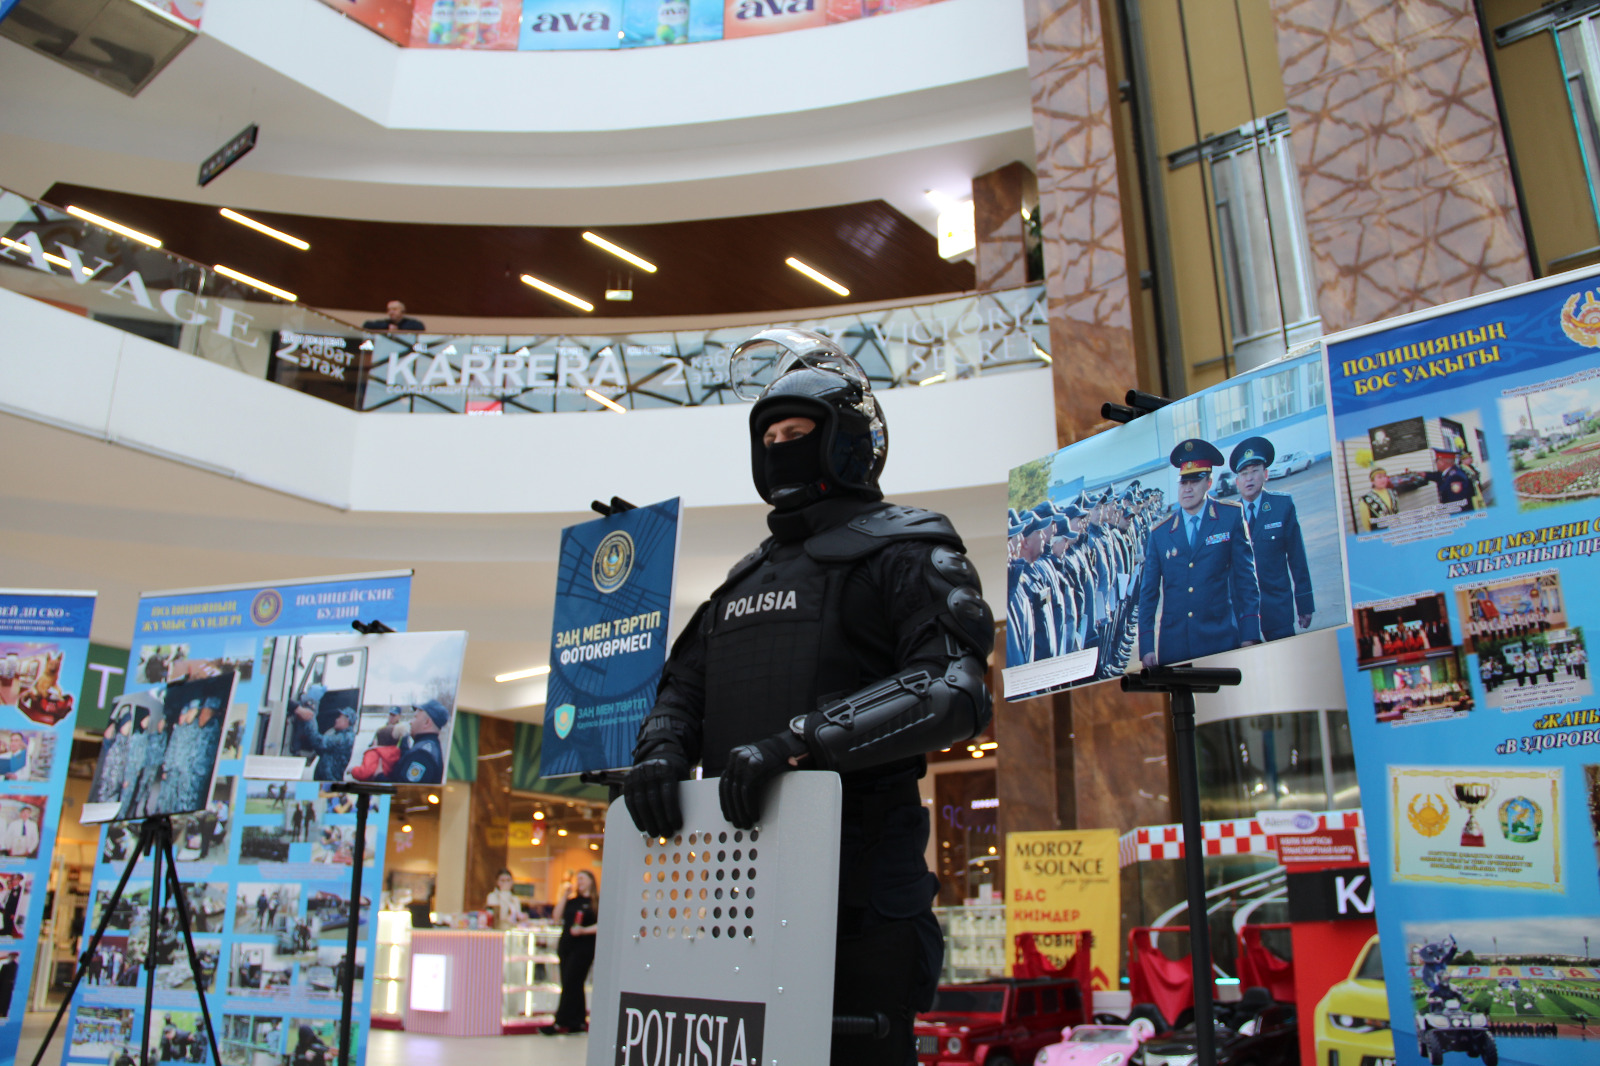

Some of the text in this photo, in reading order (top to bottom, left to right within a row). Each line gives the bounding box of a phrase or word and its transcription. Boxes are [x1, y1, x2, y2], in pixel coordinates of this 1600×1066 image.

[532, 12, 611, 33] ava
[735, 0, 815, 20] ava
[872, 300, 1048, 348] VICTORIA
[275, 331, 300, 364] 2
[1342, 322, 1507, 377] ПОЛИЦИЯНЫҢ
[300, 353, 345, 380] этаж
[385, 351, 627, 387] KARRERA
[662, 357, 686, 385] 2
[1354, 371, 1398, 396] БОС
[1402, 345, 1501, 384] УАҚЫТЫ
[1506, 520, 1590, 549] МӘДЕНИ
[1447, 540, 1574, 579] КУЛЬТУРНЫЙ
[296, 588, 395, 606] ПОЛИЦЕЙСКИЕ
[317, 605, 359, 619] БУДНИ
[724, 590, 797, 621] POLISIA
[555, 611, 661, 649] ЗАҢ МЕН ТӘРТІП
[560, 632, 651, 665] ФОТОКӨРМЕСІ
[1014, 840, 1083, 857] MOROZ
[1035, 858, 1104, 875] SOLNCE
[1014, 889, 1046, 901] БАС
[621, 1007, 750, 1066] POLISIA
